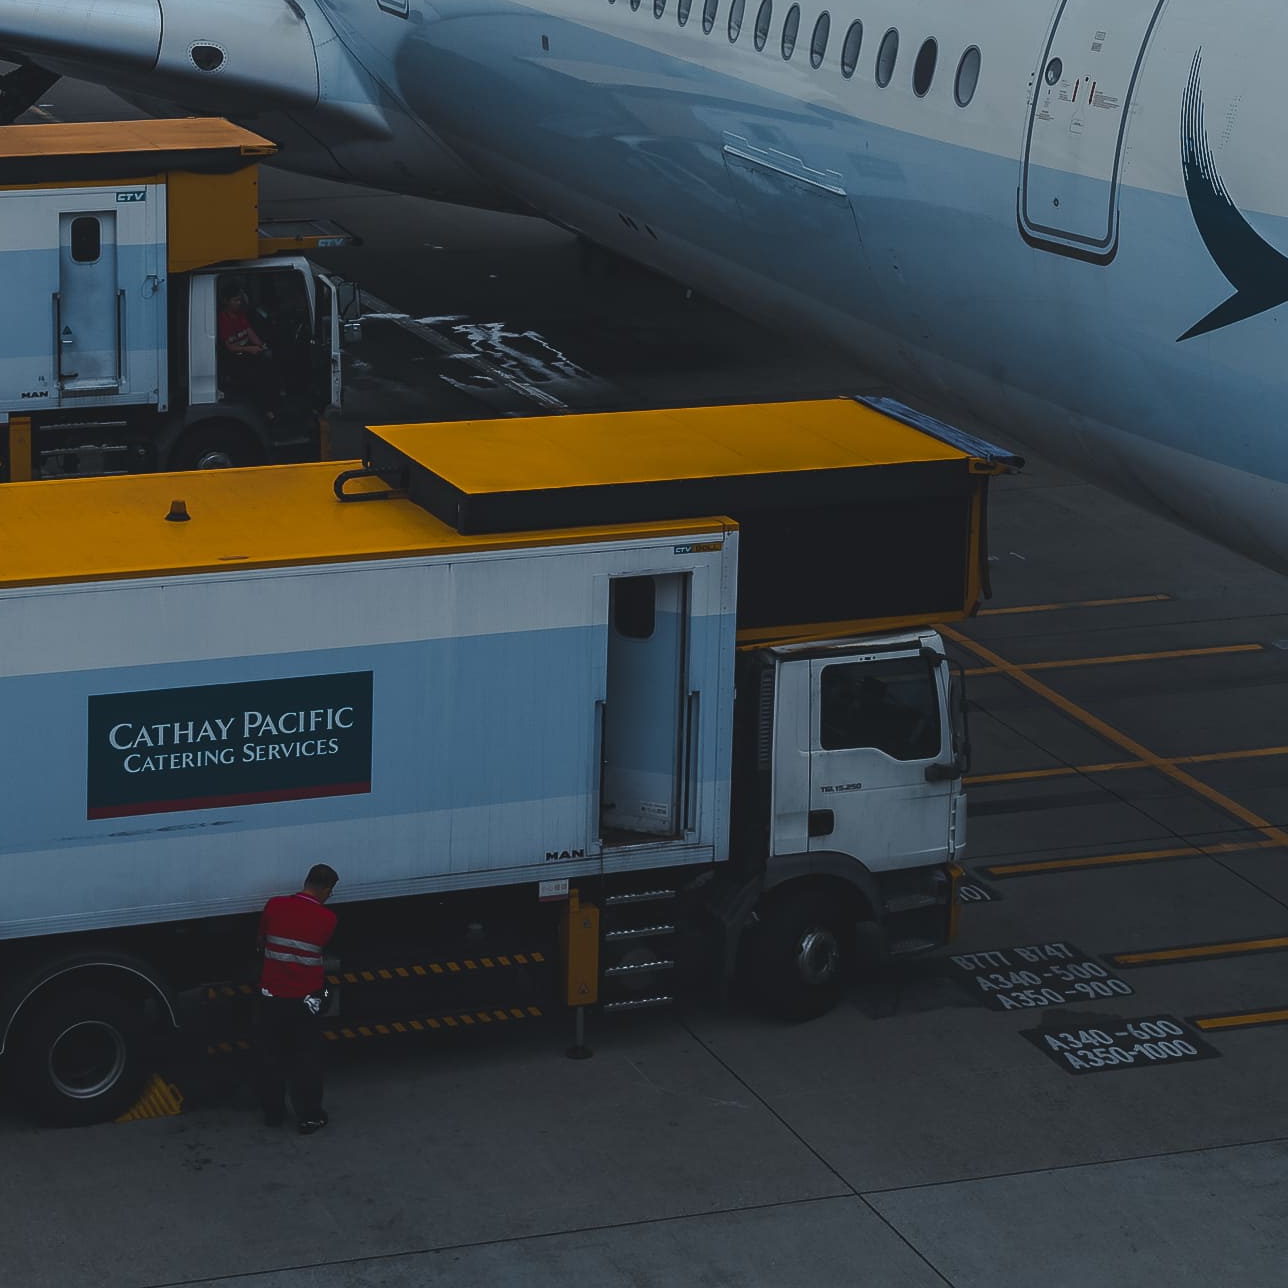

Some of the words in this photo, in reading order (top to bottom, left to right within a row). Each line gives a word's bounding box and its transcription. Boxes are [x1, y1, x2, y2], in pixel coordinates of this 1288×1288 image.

[117, 192, 145, 202] CTV
[317, 238, 344, 248] CTV
[21, 390, 49, 399] MAN
[674, 545, 692, 554] CTV
[108, 717, 237, 751] CATHAY
[243, 705, 355, 738] PACIFIC
[123, 748, 235, 774] CATERING
[242, 738, 339, 763] SERVICES
[545, 848, 585, 861] MAN
[950, 951, 1011, 971] B777
[1013, 942, 1074, 963] B747
[1063, 1039, 1199, 1071] A350-1000
